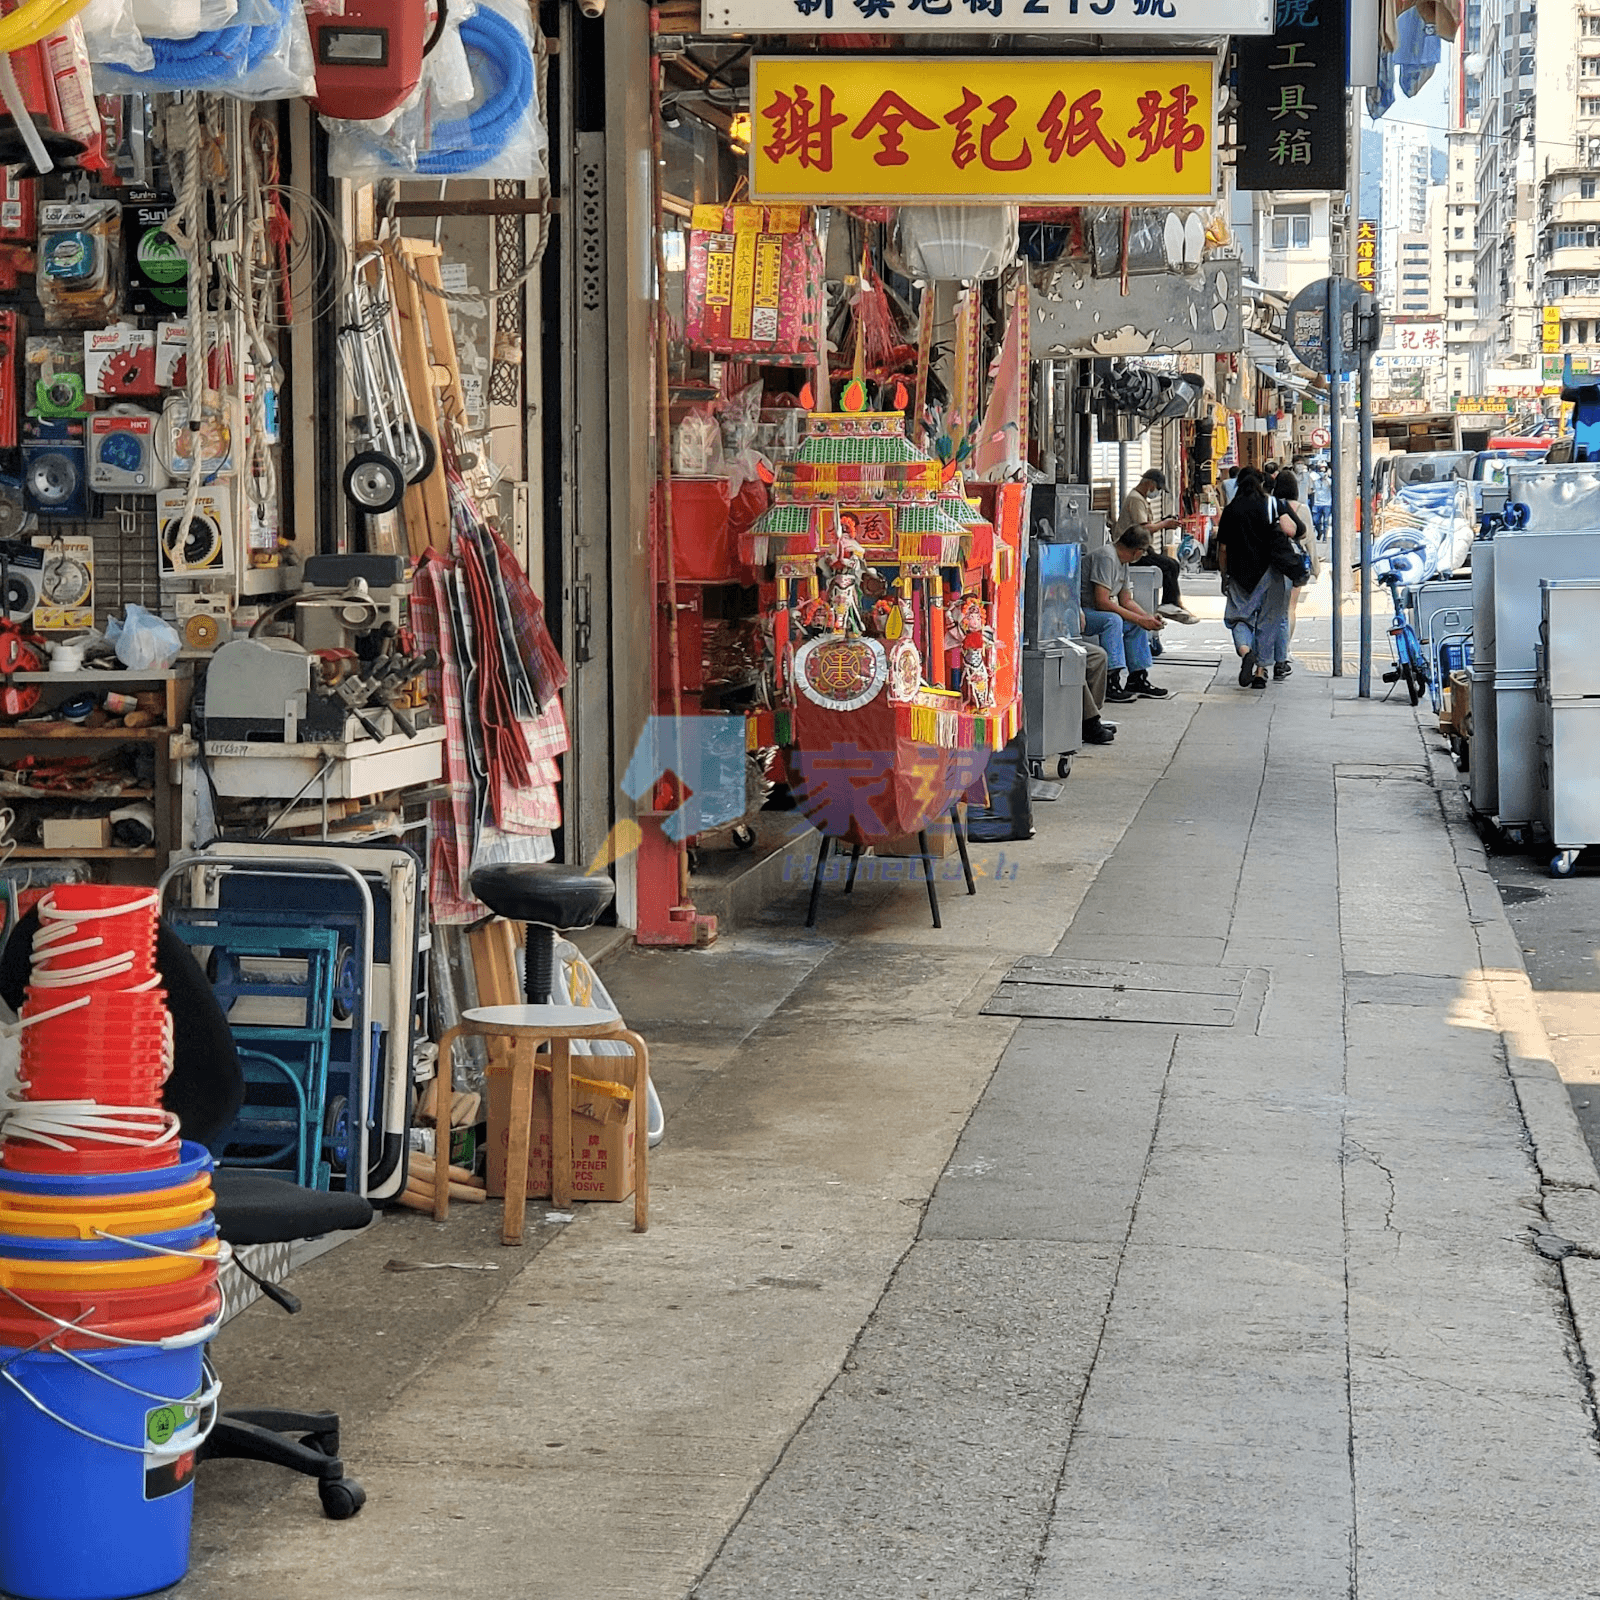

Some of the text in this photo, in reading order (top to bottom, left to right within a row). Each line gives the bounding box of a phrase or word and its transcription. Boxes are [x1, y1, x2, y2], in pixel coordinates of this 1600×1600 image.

[762, 83, 1205, 173] 謝全記紙號
[1267, 42, 1319, 166] 工具箱
[130, 421, 148, 429] HKT
[575, 1171, 593, 1181] PCS
